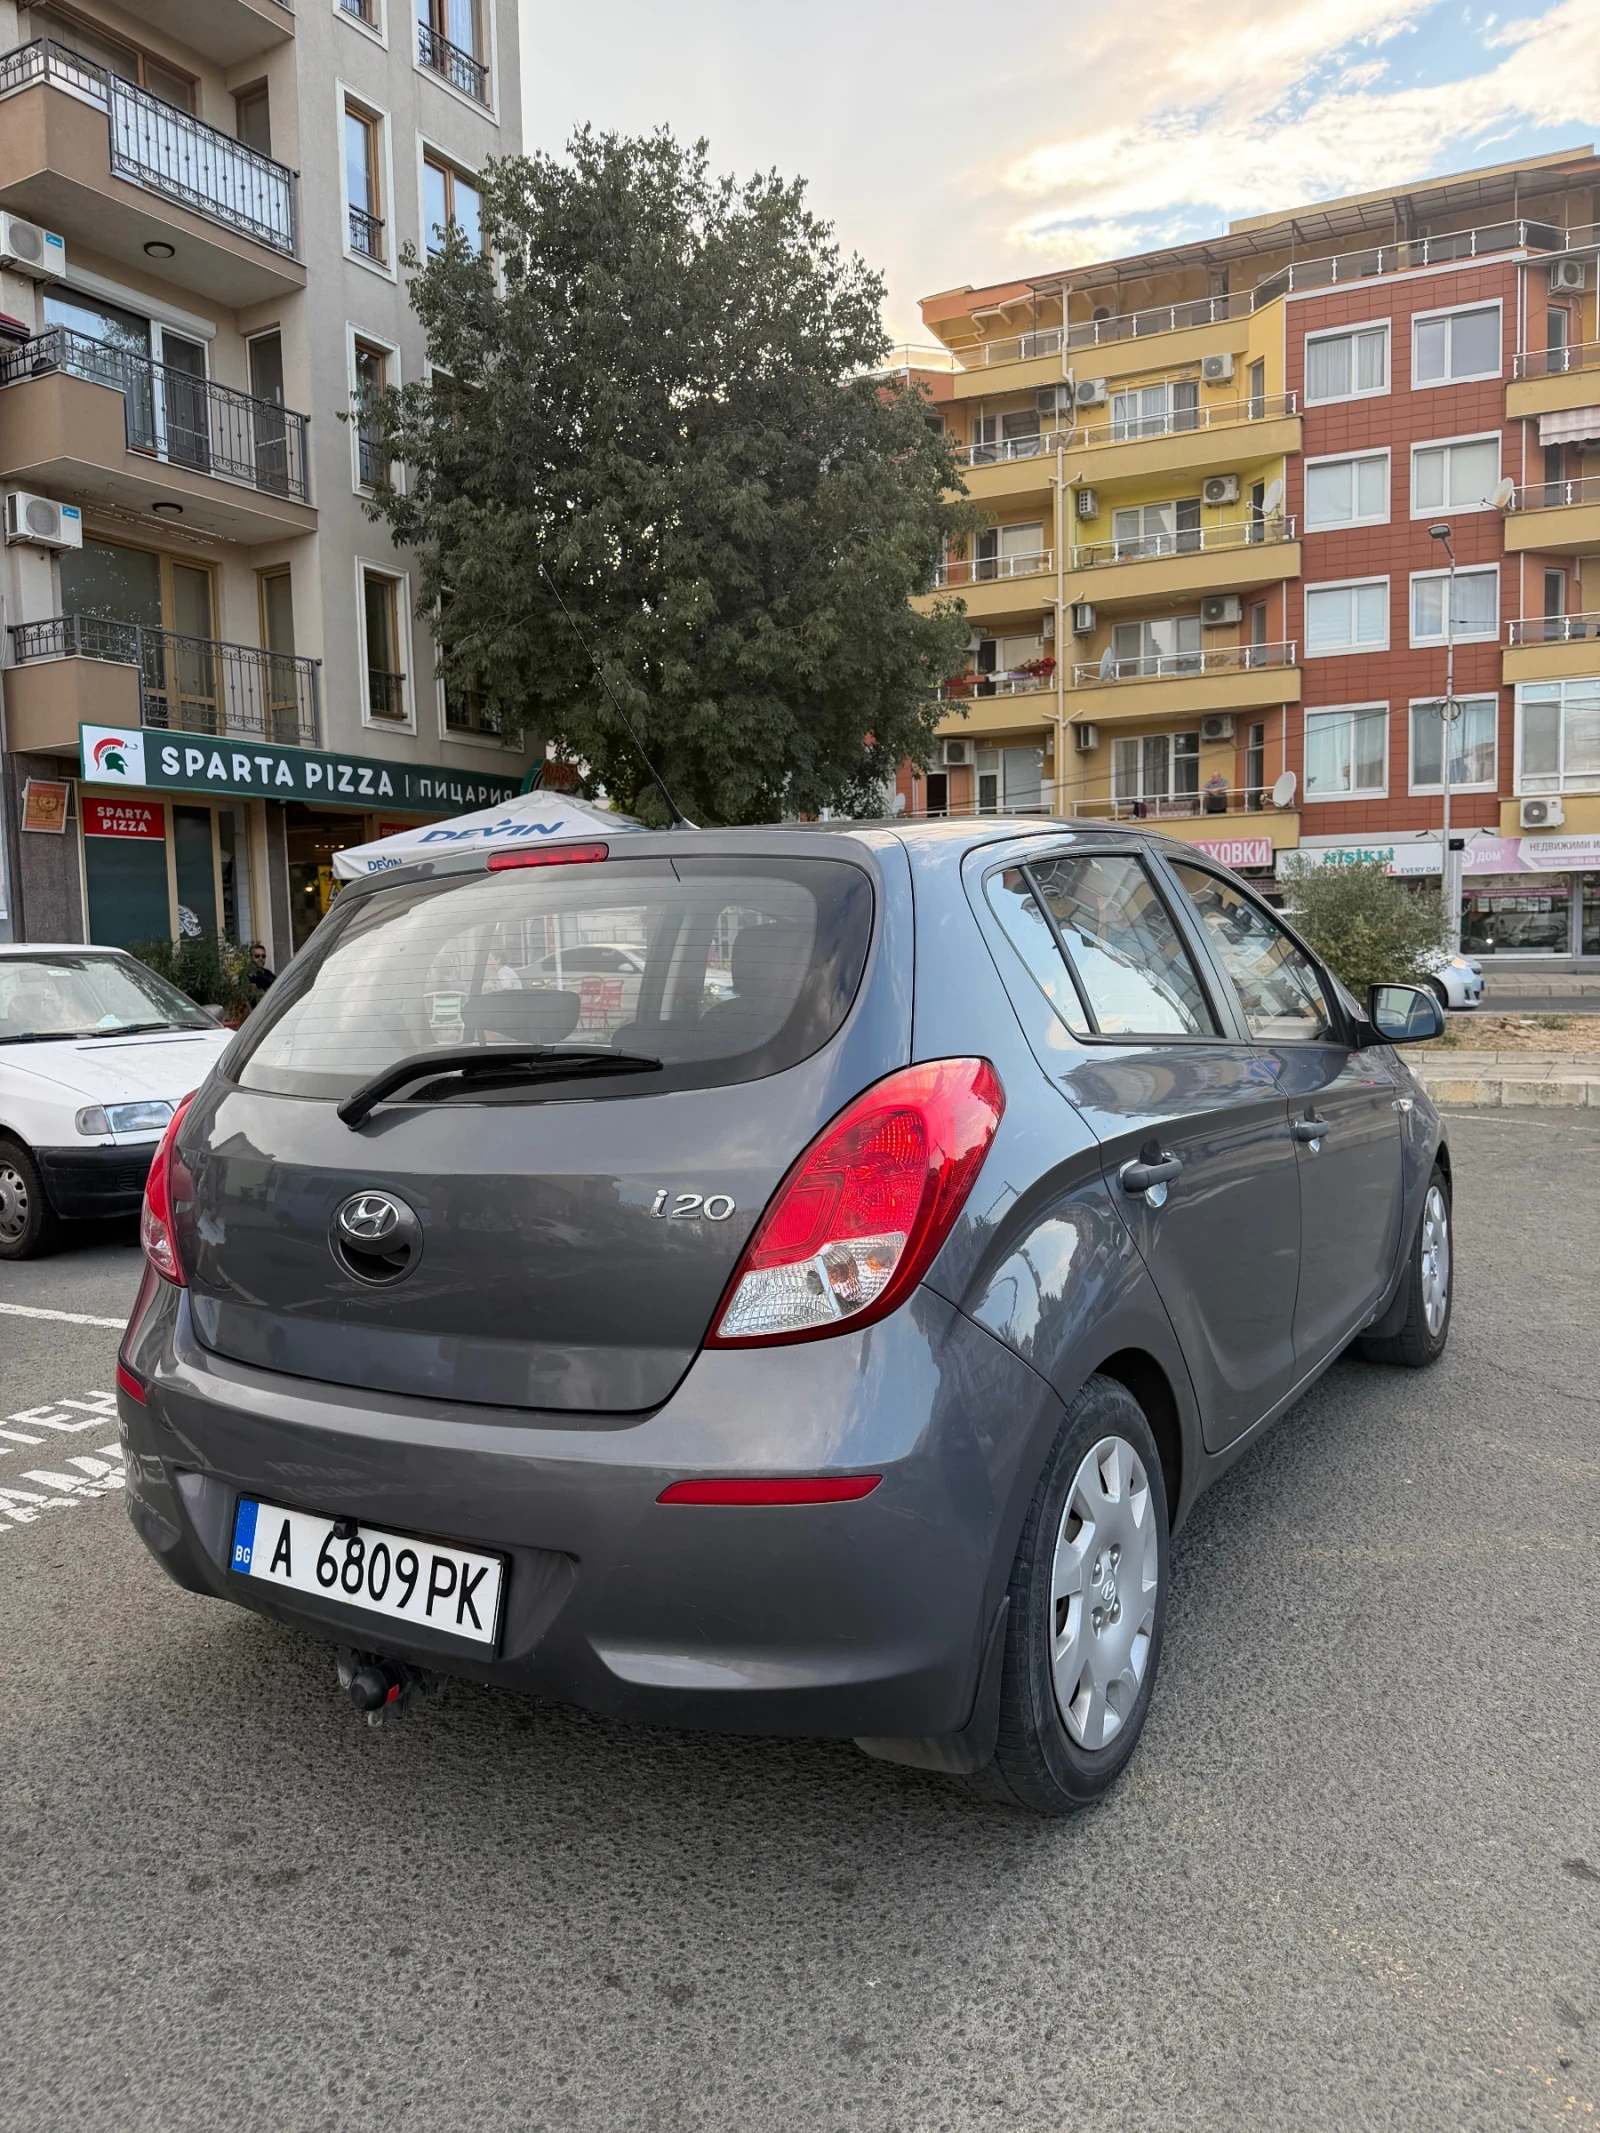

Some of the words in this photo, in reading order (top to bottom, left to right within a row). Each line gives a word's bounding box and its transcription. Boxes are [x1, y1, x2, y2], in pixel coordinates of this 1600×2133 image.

[161, 746, 294, 787] SPARTA
[305, 762, 393, 797] PIZZA
[420, 778, 513, 805] ПИЦАРИЯ
[97, 806, 152, 820] SPARTA
[102, 819, 148, 832] PIZZA
[418, 819, 565, 843] DEVIN
[1530, 840, 1590, 852] НЕДВИЖИМИ
[367, 857, 402, 871] DEVIN
[651, 1189, 736, 1221] i20
[235, 1544, 251, 1564] BG
[269, 1519, 292, 1578] A
